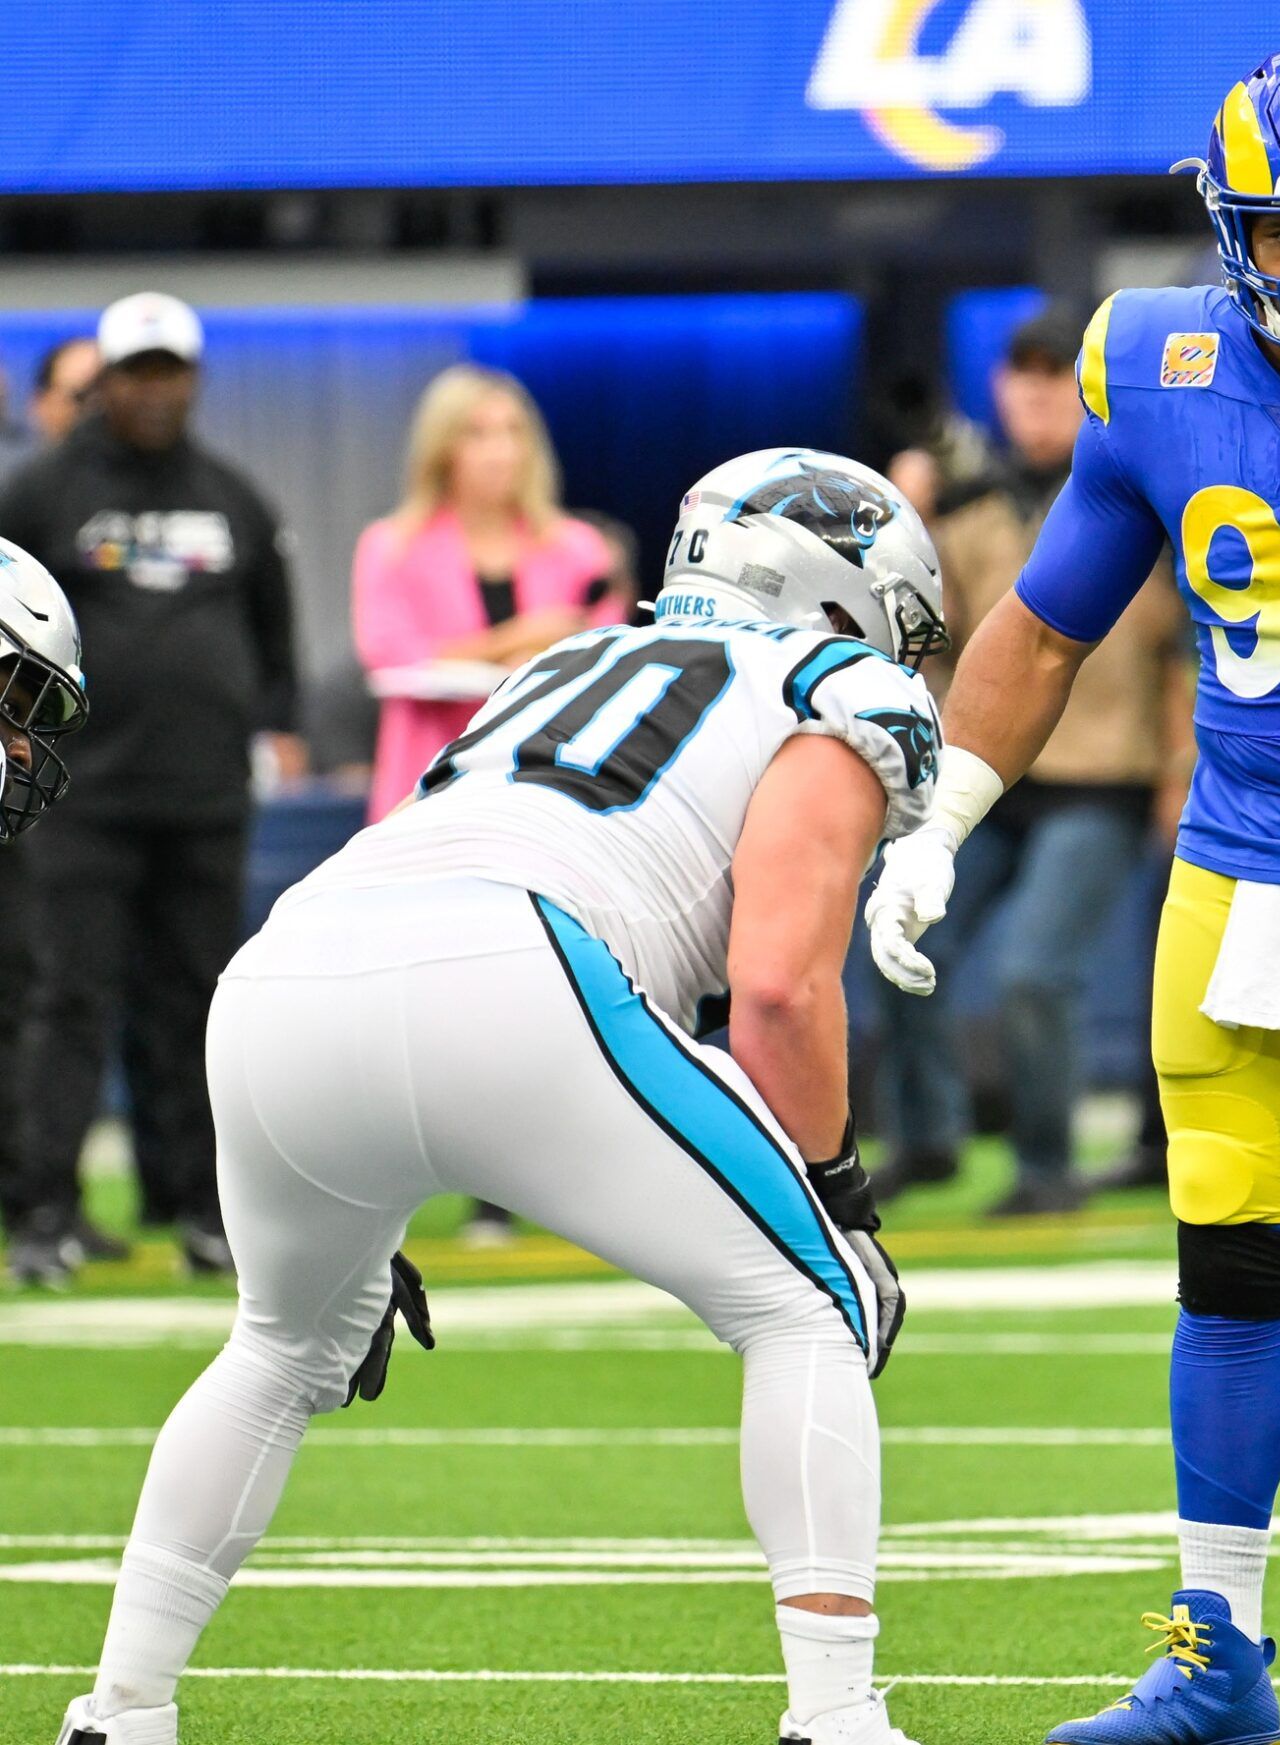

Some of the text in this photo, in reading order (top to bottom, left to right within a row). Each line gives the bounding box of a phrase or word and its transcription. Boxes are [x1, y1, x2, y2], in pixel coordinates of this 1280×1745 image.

[804, 0, 1094, 112] LA
[668, 529, 709, 566] 70
[656, 595, 716, 618] THERS
[415, 633, 736, 816] 70
